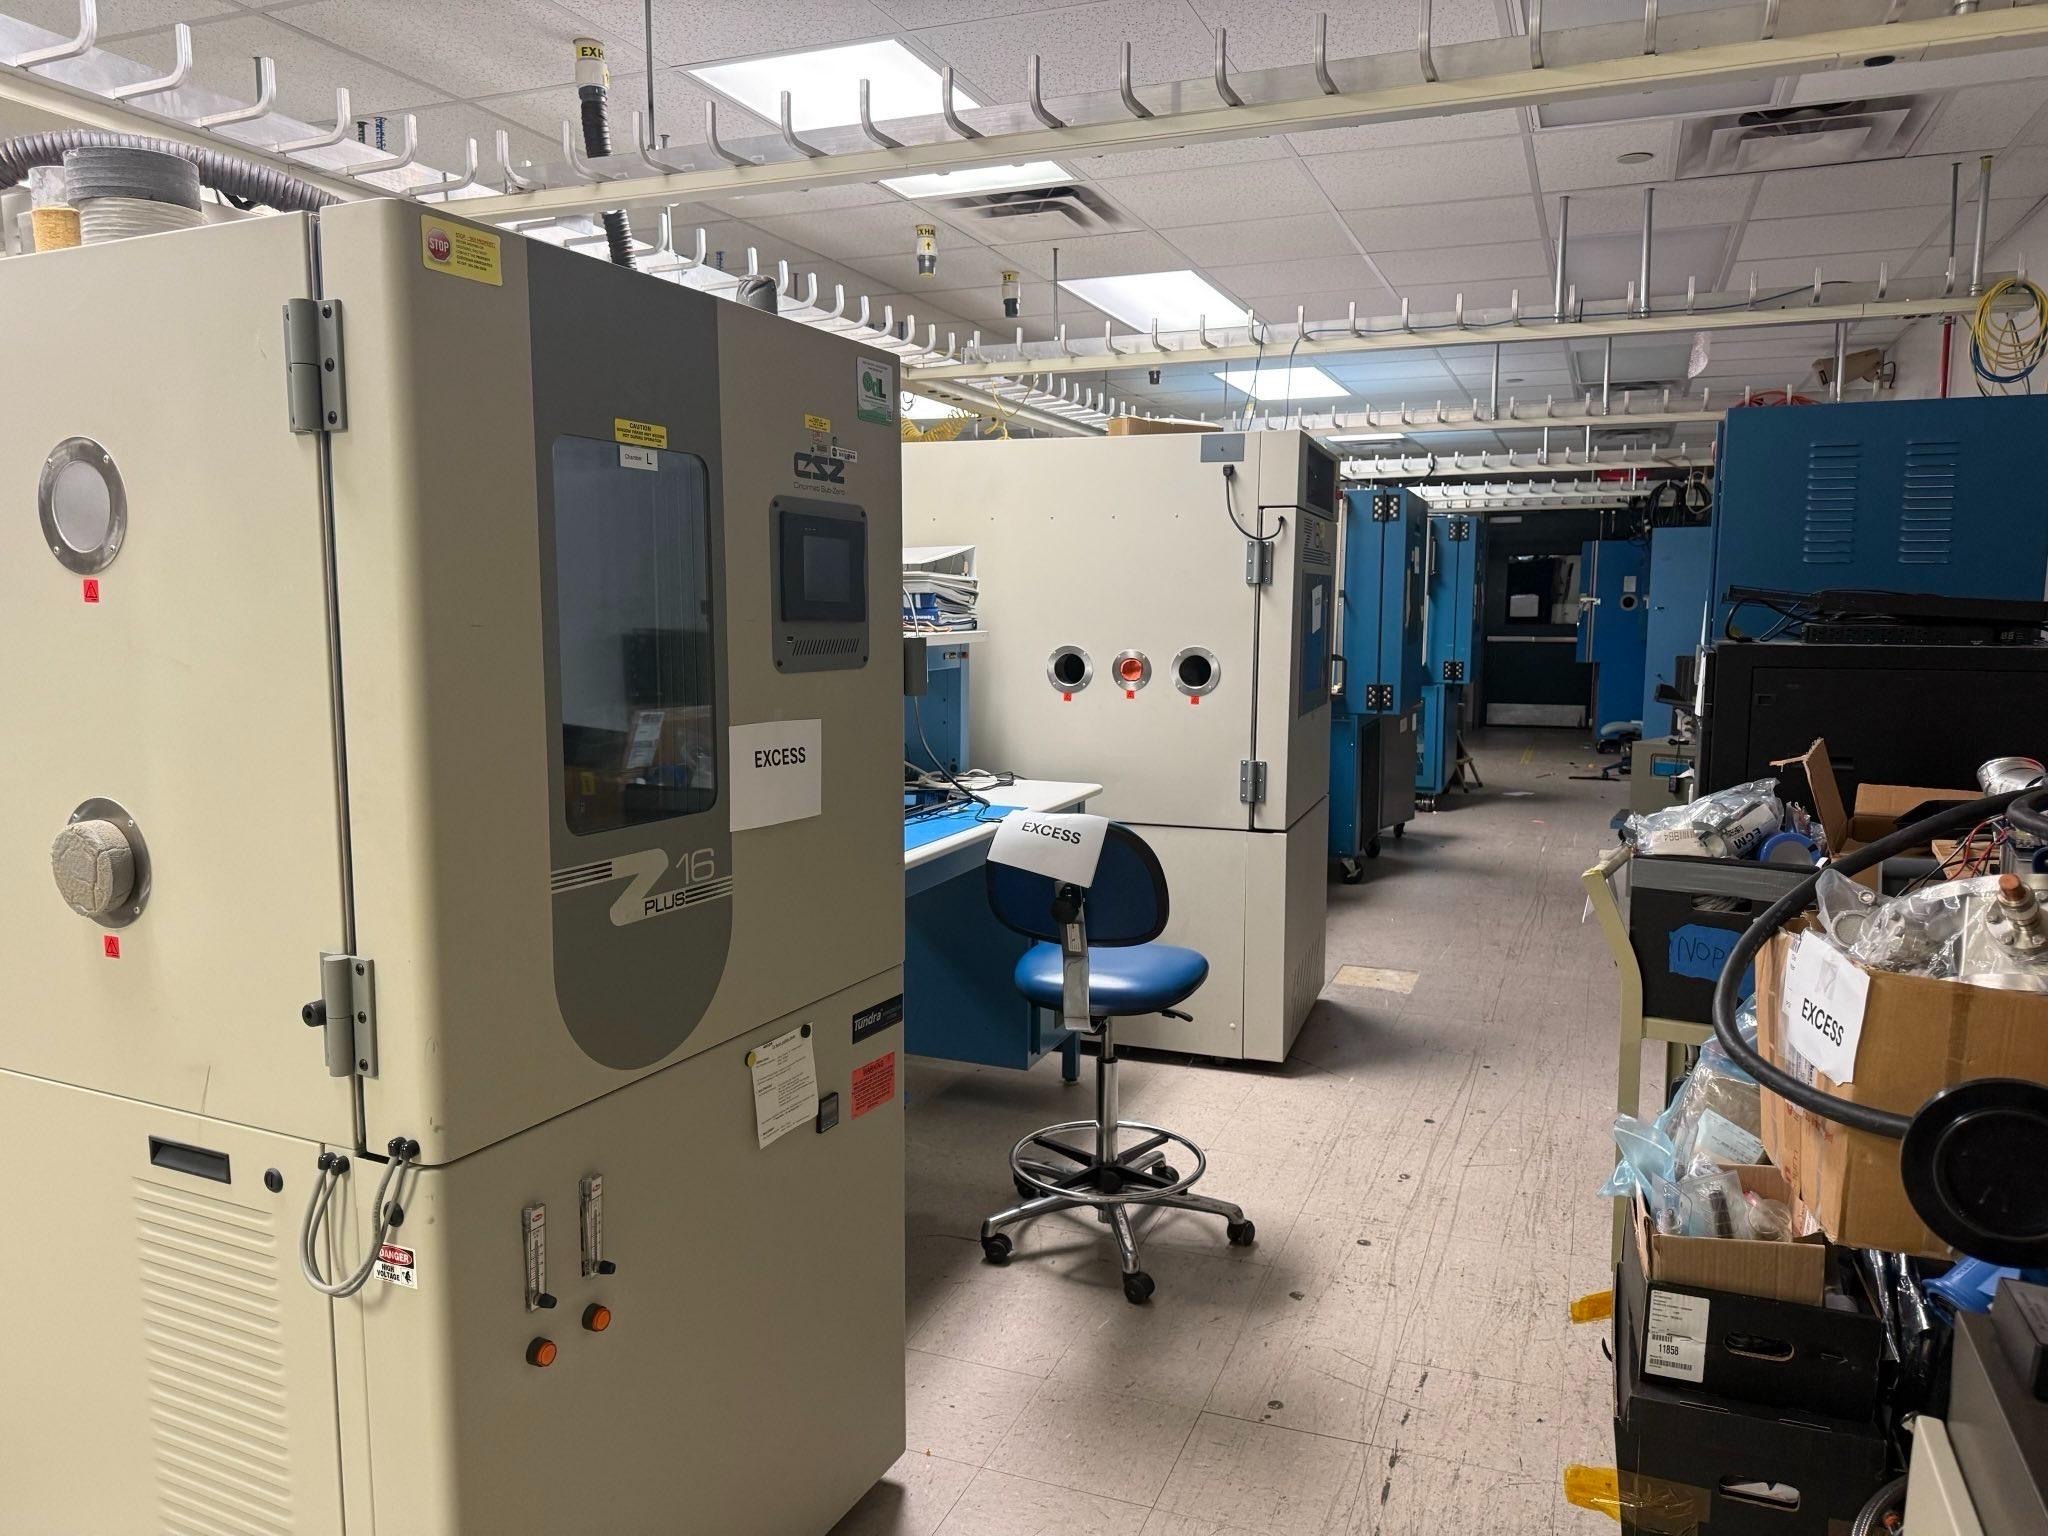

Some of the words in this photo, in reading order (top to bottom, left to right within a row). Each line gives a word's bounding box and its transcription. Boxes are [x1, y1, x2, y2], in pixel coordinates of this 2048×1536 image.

[429, 237, 450, 253] STOP
[629, 422, 652, 432] CAUTION
[646, 452, 653, 465] L
[794, 452, 845, 484] CSZ
[754, 746, 806, 768] EXCESS
[1021, 821, 1082, 844] EXCESS
[675, 847, 715, 885] 16
[644, 891, 686, 916] PLUS
[854, 1011, 882, 1032] Tundra
[1801, 997, 1844, 1047] EXCESS
[379, 1247, 409, 1263] DANGER
[376, 1269, 401, 1282] VOLTAGE
[381, 1263, 395, 1273] HIGH
[1658, 1344, 1679, 1356] 11858
